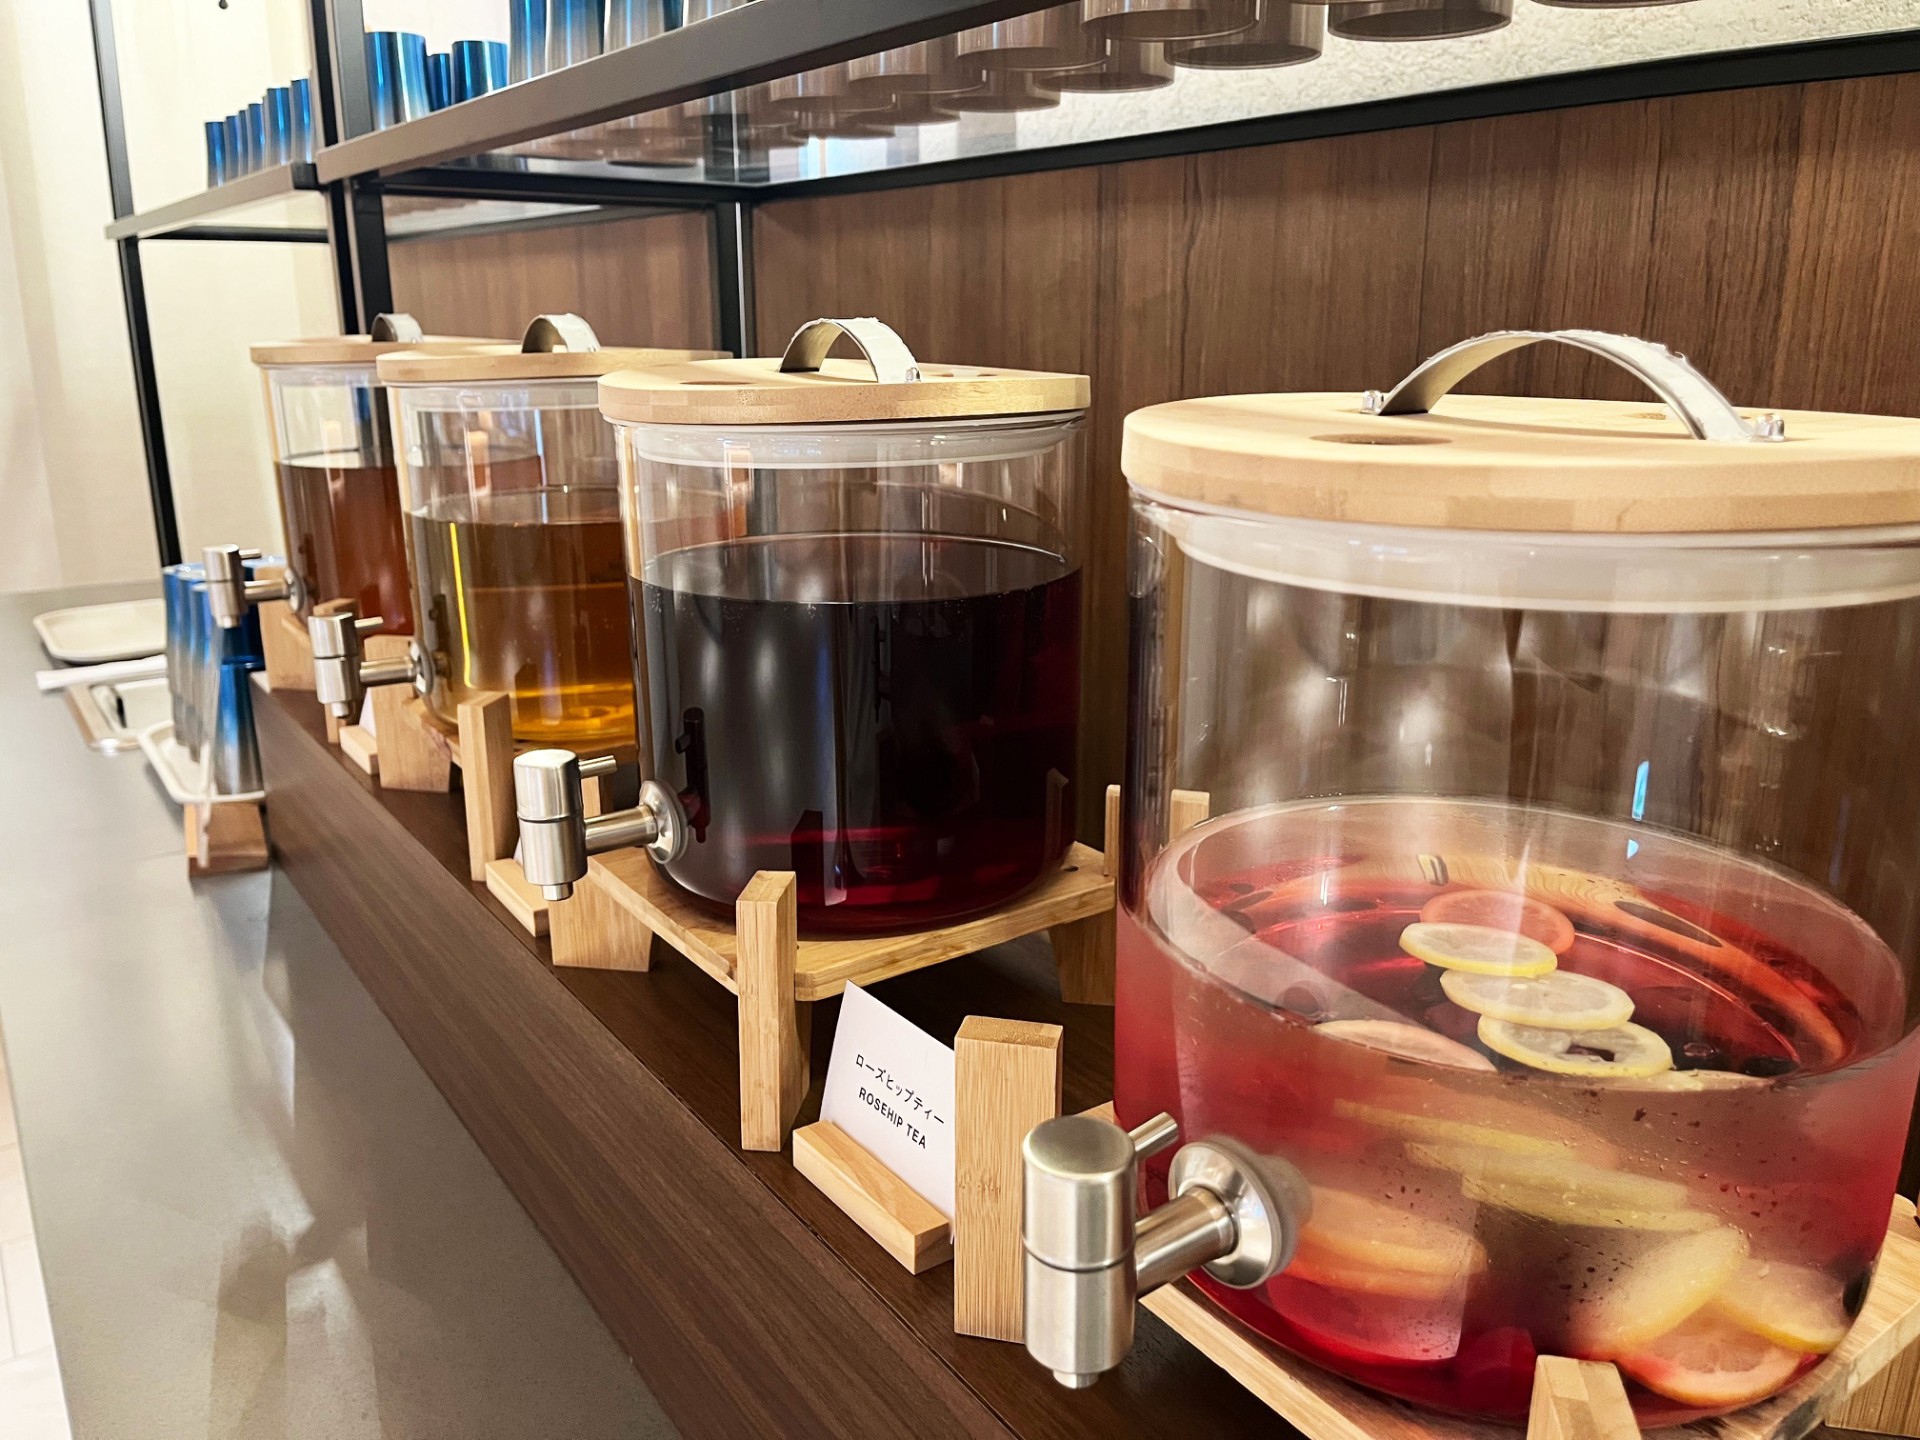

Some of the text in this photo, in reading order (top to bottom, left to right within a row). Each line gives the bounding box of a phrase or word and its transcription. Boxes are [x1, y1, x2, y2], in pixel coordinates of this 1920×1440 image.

[855, 1053, 945, 1125] ローズヒップティー
[858, 1086, 927, 1149] ROSEHIP TEA
